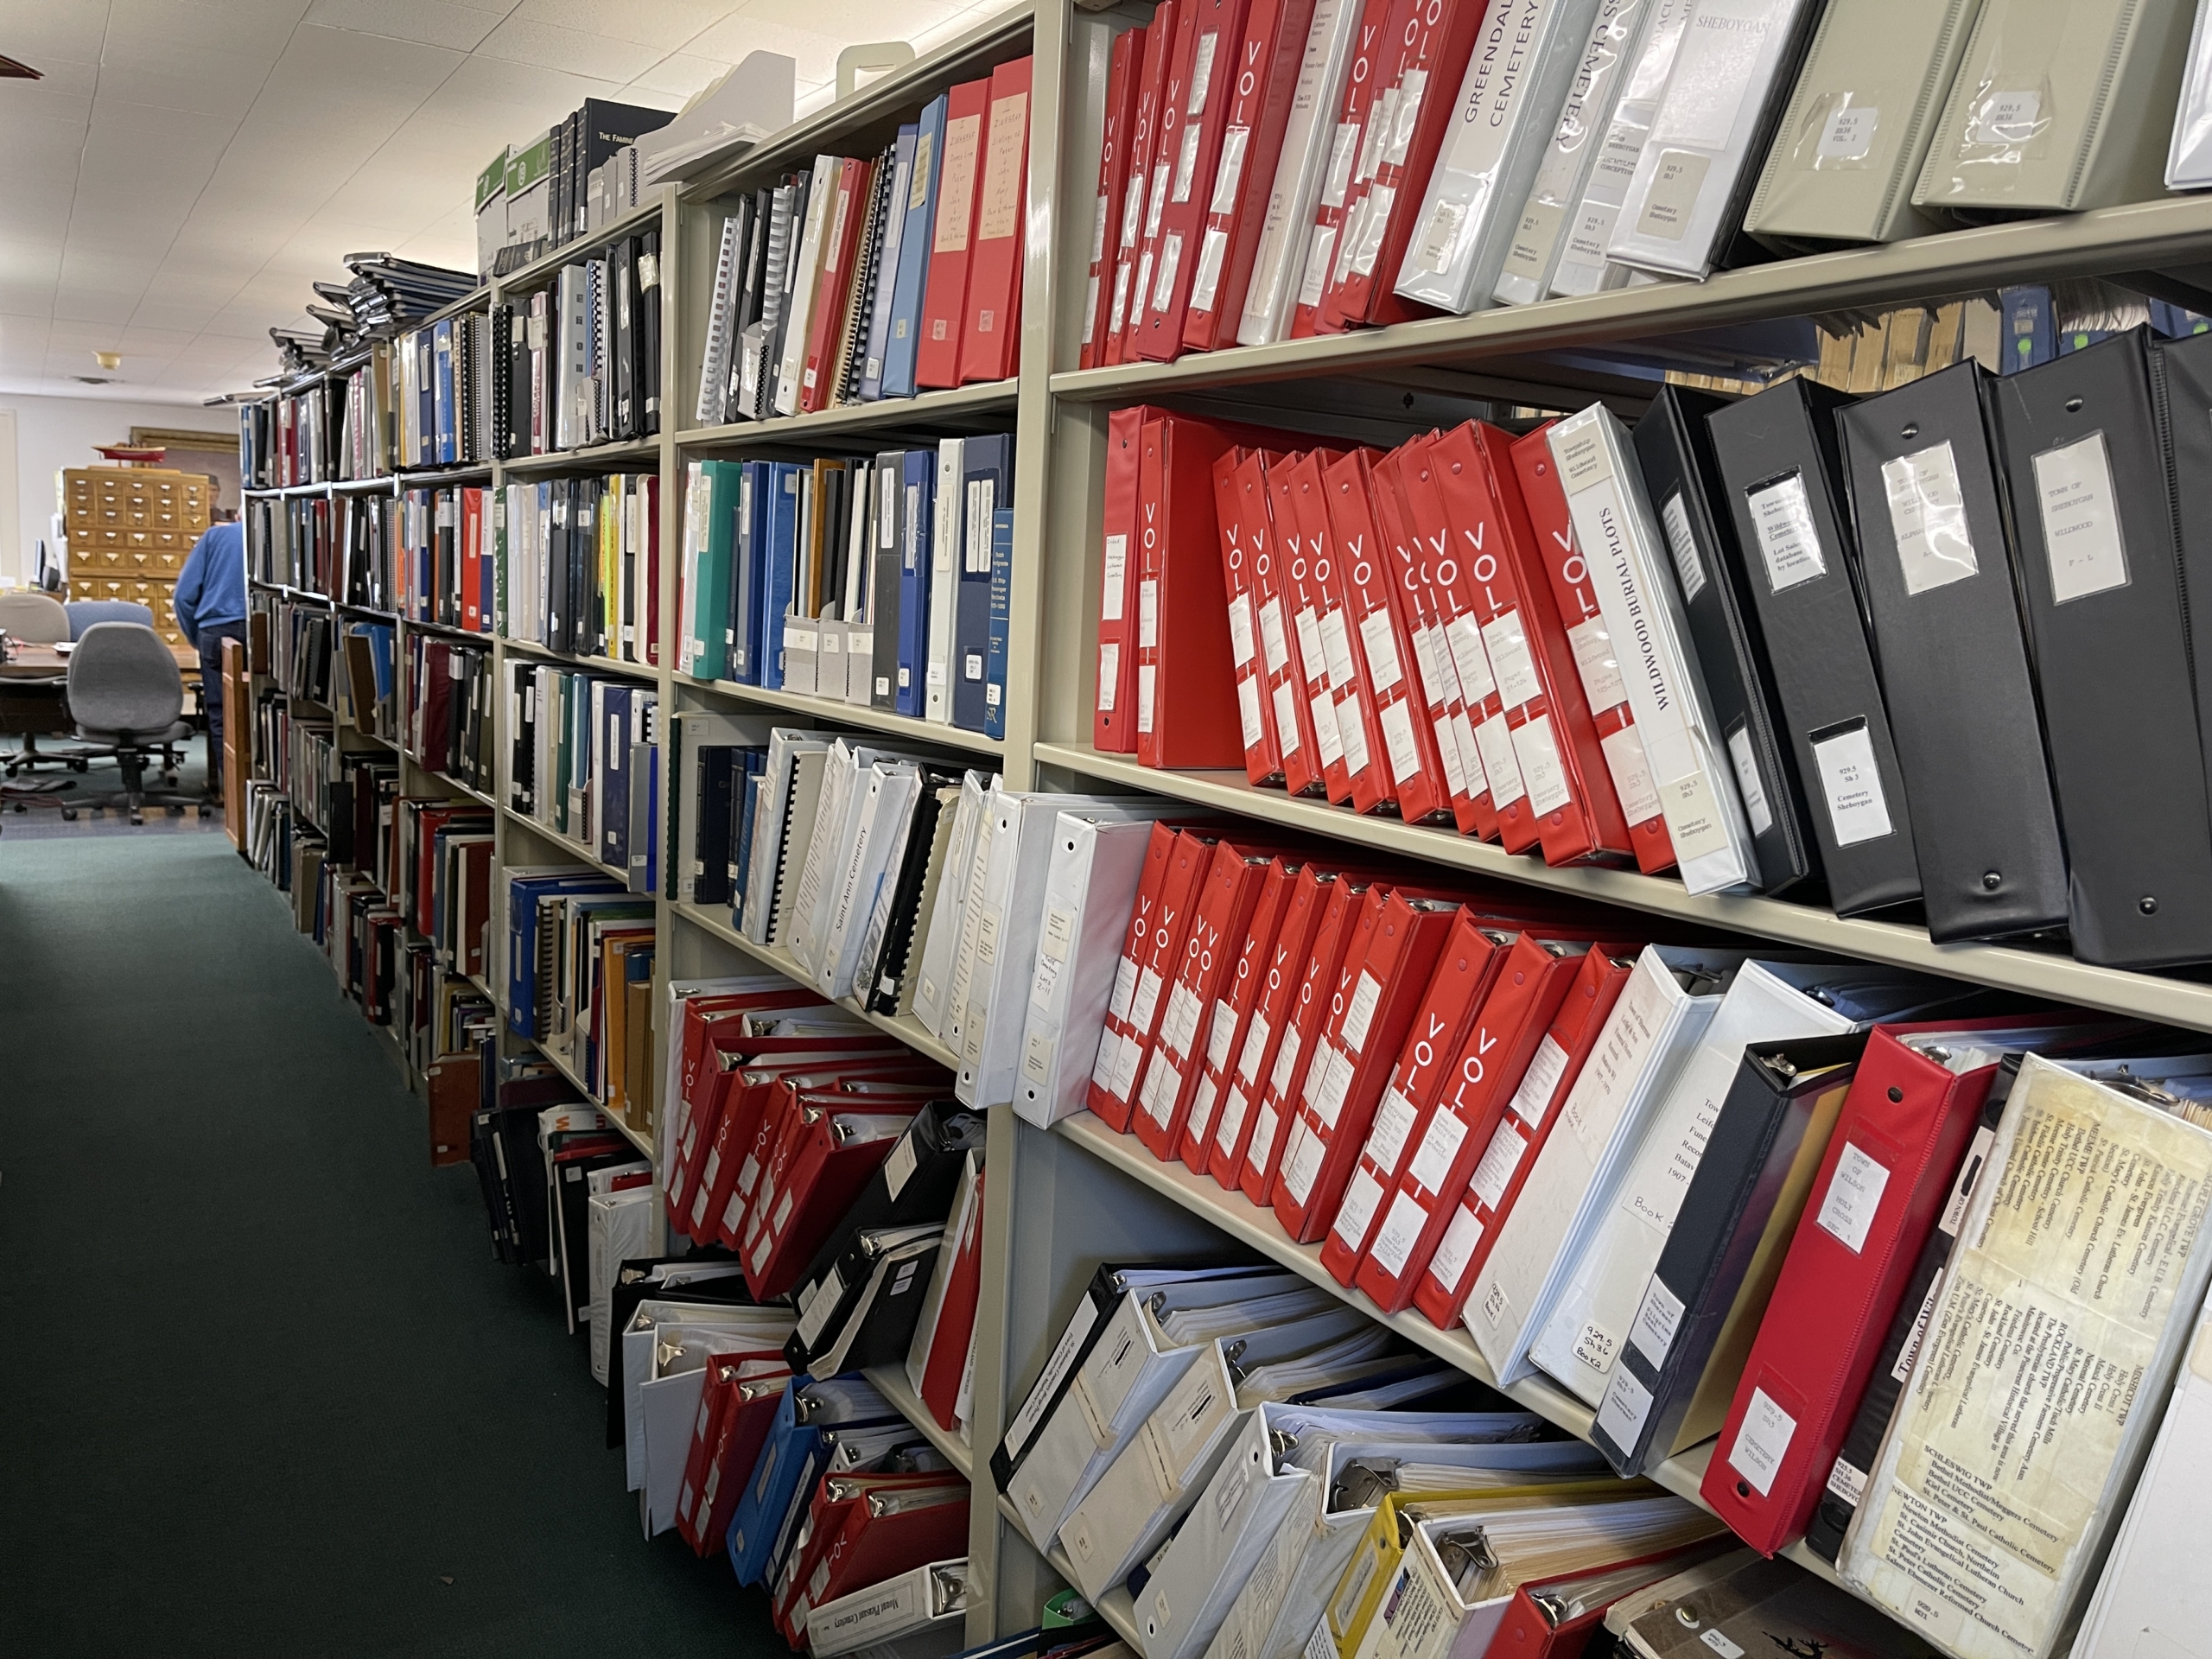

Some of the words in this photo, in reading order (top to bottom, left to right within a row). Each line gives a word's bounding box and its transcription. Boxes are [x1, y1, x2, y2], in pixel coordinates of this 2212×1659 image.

[1695, 15, 1770, 34] SHEBOYGAN
[1349, 25, 1376, 112] VOL
[1490, 1, 1539, 127] CEMETERY
[1236, 41, 1262, 124] VOL
[1555, 24, 1609, 148] CEMETERY
[1136, 91, 1150, 166] VOL
[1162, 79, 1179, 156] VOL
[598, 131, 611, 142] THE
[612, 134, 634, 145] FAMINE
[1103, 115, 1115, 186] VOL
[1666, 164, 1683, 173] 929.5
[1651, 204, 1677, 215] Cemetery
[1573, 237, 1600, 249] Cemetery
[1567, 443, 1595, 461] Sheboygan
[1569, 455, 1596, 473] Wildwood
[1571, 462, 1598, 479] Cemetery
[2048, 486, 2068, 498] TOWN
[2070, 481, 2082, 490] OF
[2051, 493, 2094, 512] SHEBOYGAN
[1144, 502, 1155, 571] VOL
[1599, 506, 1623, 556] PLOTS
[2055, 520, 2093, 537] WILDWOOD
[1227, 523, 1243, 592] VOL
[1253, 528, 1272, 597] VOL
[1287, 532, 1309, 602] VOL
[1310, 531, 1332, 606] VOL
[1347, 534, 1375, 609] VOL
[1429, 528, 1462, 613] VOL
[1465, 521, 1503, 611] VOL
[1552, 523, 1595, 614] VOL
[1775, 550, 1802, 563] database
[1787, 556, 1811, 568] location
[1616, 557, 1642, 617] BURIAL
[1633, 620, 1669, 712] WILDWOOD
[1680, 780, 1698, 791] 929.5
[1839, 766, 1857, 775] 929.5
[1837, 791, 1869, 802] Cemetery
[1837, 798, 1872, 810] Sheboygan
[1678, 817, 1706, 831] Cemetery
[1680, 823, 1712, 838] Sheboygan
[836, 904, 848, 932] Saint
[843, 880, 853, 904] Ann
[849, 825, 867, 880] Cemetery
[1132, 895, 1151, 957] VOL
[1153, 906, 1175, 969] VOL
[1184, 914, 1207, 979] VOL
[1197, 926, 1218, 992] VOL
[1233, 933, 1255, 1000] VOL
[1264, 944, 1287, 1012] VOL
[1296, 957, 1319, 1027] VOL
[1327, 966, 1352, 1038] VOL
[1407, 1013, 1446, 1091] VOL
[686, 1059, 695, 1100] VOL
[1454, 1027, 1497, 1109] VOL
[1704, 1098, 1720, 1114] Tow
[718, 1114, 731, 1153] VOL
[754, 1118, 772, 1157] VOL
[2062, 1122, 2075, 1141] Holy
[2071, 1127, 2086, 1152] Bethel
[2083, 1122, 2101, 1154] MEEME
[1853, 1153, 1871, 1168] TOWN
[2052, 1142, 2069, 1166] Trinity
[2064, 1152, 2078, 1172] UCC
[2076, 1155, 2089, 1175] TWP
[1667, 1166, 1686, 1183] 1907
[1840, 1171, 1866, 1193] WILSON
[1852, 1166, 1862, 1176] OF
[2040, 1167, 2059, 1201] Cemetery
[2055, 1171, 2070, 1198] Church
[1832, 1206, 1853, 1225] CROSS
[1835, 1196, 1853, 1211] HOLY
[1949, 1207, 1962, 1225] TOWN
[2031, 1206, 2045, 1231] School
[2042, 1198, 2061, 1231] Cemetery
[1826, 1220, 1841, 1236] SEC.
[2184, 1205, 2202, 1238] GROVE
[2025, 1230, 2037, 1246] Hill
[2177, 1237, 2191, 1258] TWP
[1649, 1298, 1673, 1325] Sherman
[1652, 1293, 1665, 1310] Town
[1642, 1318, 1668, 1347] Cemetery
[1646, 1306, 1672, 1338] Pilgrims
[1996, 1303, 2013, 1338] Rockland
[2006, 1309, 2023, 1338] Friedens
[2017, 1305, 2037, 1343] Manitowoc
[1586, 1325, 1613, 1348] 929.5
[2012, 1344, 2022, 1356] Co.
[2045, 1322, 2069, 1370] ROCKLAND
[1983, 1336, 2001, 1369] Cemetery
[1994, 1339, 2012, 1371] Cemetery
[2039, 1370, 2051, 1389] TWP
[2103, 1363, 2118, 1382] Holy
[2114, 1369, 2129, 1388] Holy
[2122, 1364, 2145, 1408] MISHICOT
[1612, 1391, 1638, 1421] Cemetery
[2096, 1382, 2110, 1402] Cross
[2108, 1388, 2121, 1408] Cross
[1611, 1396, 1633, 1422] Sherman
[1763, 1401, 1783, 1422] 929.5
[2115, 1408, 2129, 1427] TWP
[1744, 1446, 1768, 1471] WILSON
[1745, 1433, 1776, 1465] CEMETERY
[1924, 1445, 1972, 1478] SCHLESWIG
[1974, 1477, 1993, 1491] TWP
[1891, 1485, 1928, 1511] NEWTON
[1929, 1510, 1948, 1523] TWP
[1925, 1478, 1940, 1492] Kiel
[1941, 1488, 1975, 1513] Cemetery
[1928, 1469, 1950, 1486] Bethel
[1952, 1482, 1970, 1499] UCC
[1970, 1495, 2005, 1522] Cemetery
[1931, 1460, 1953, 1477] Bethel
[1954, 1471, 2022, 1521] Methodist/Meggers
[2023, 1518, 2059, 1543] Cemetery
[1894, 1529, 1927, 1554] Cemetery
[1903, 1502, 1929, 1522] Newton
[1929, 1520, 1964, 1546] Methodist
[1966, 1543, 2000, 1568] Cemetery
[1933, 1493, 1951, 1510] Peter
[1972, 1518, 1987, 1533] Paul
[1989, 1529, 2019, 1552] Catholic
[2020, 1548, 2056, 1574] Cemetery
[829, 1531, 847, 1567] VOL
[1910, 1519, 1938, 1540] Casimir
[1938, 1536, 1967, 1559] Church,
[1967, 1554, 2000, 1580] Northeim
[1898, 1551, 1917, 1568] Peter
[1917, 1566, 1946, 1588] Catholic
[1947, 1586, 1980, 1610] Cemetery
[1901, 1543, 1922, 1561] Paul's
[1922, 1557, 1953, 1581] Lutheran
[1954, 1578, 1987, 1604] Cemetery
[1907, 1526, 1923, 1541] John
[1925, 1537, 1964, 1568] Evangelical
[1965, 1565, 1997, 1588] Lutheran
[1998, 1585, 2024, 1606] Church
[880, 1597, 899, 1614] Mount
[1885, 1554, 1906, 1572] Salem
[1907, 1568, 1938, 1593] Ebenezer
[1939, 1590, 1974, 1616] Reformed
[1974, 1613, 2001, 1633] Church
[1917, 1599, 1939, 1618] 929.5
[834, 1613, 858, 1629] Cemetery
[858, 1604, 880, 1621] Pleasant
[1914, 1608, 1928, 1620] M31
